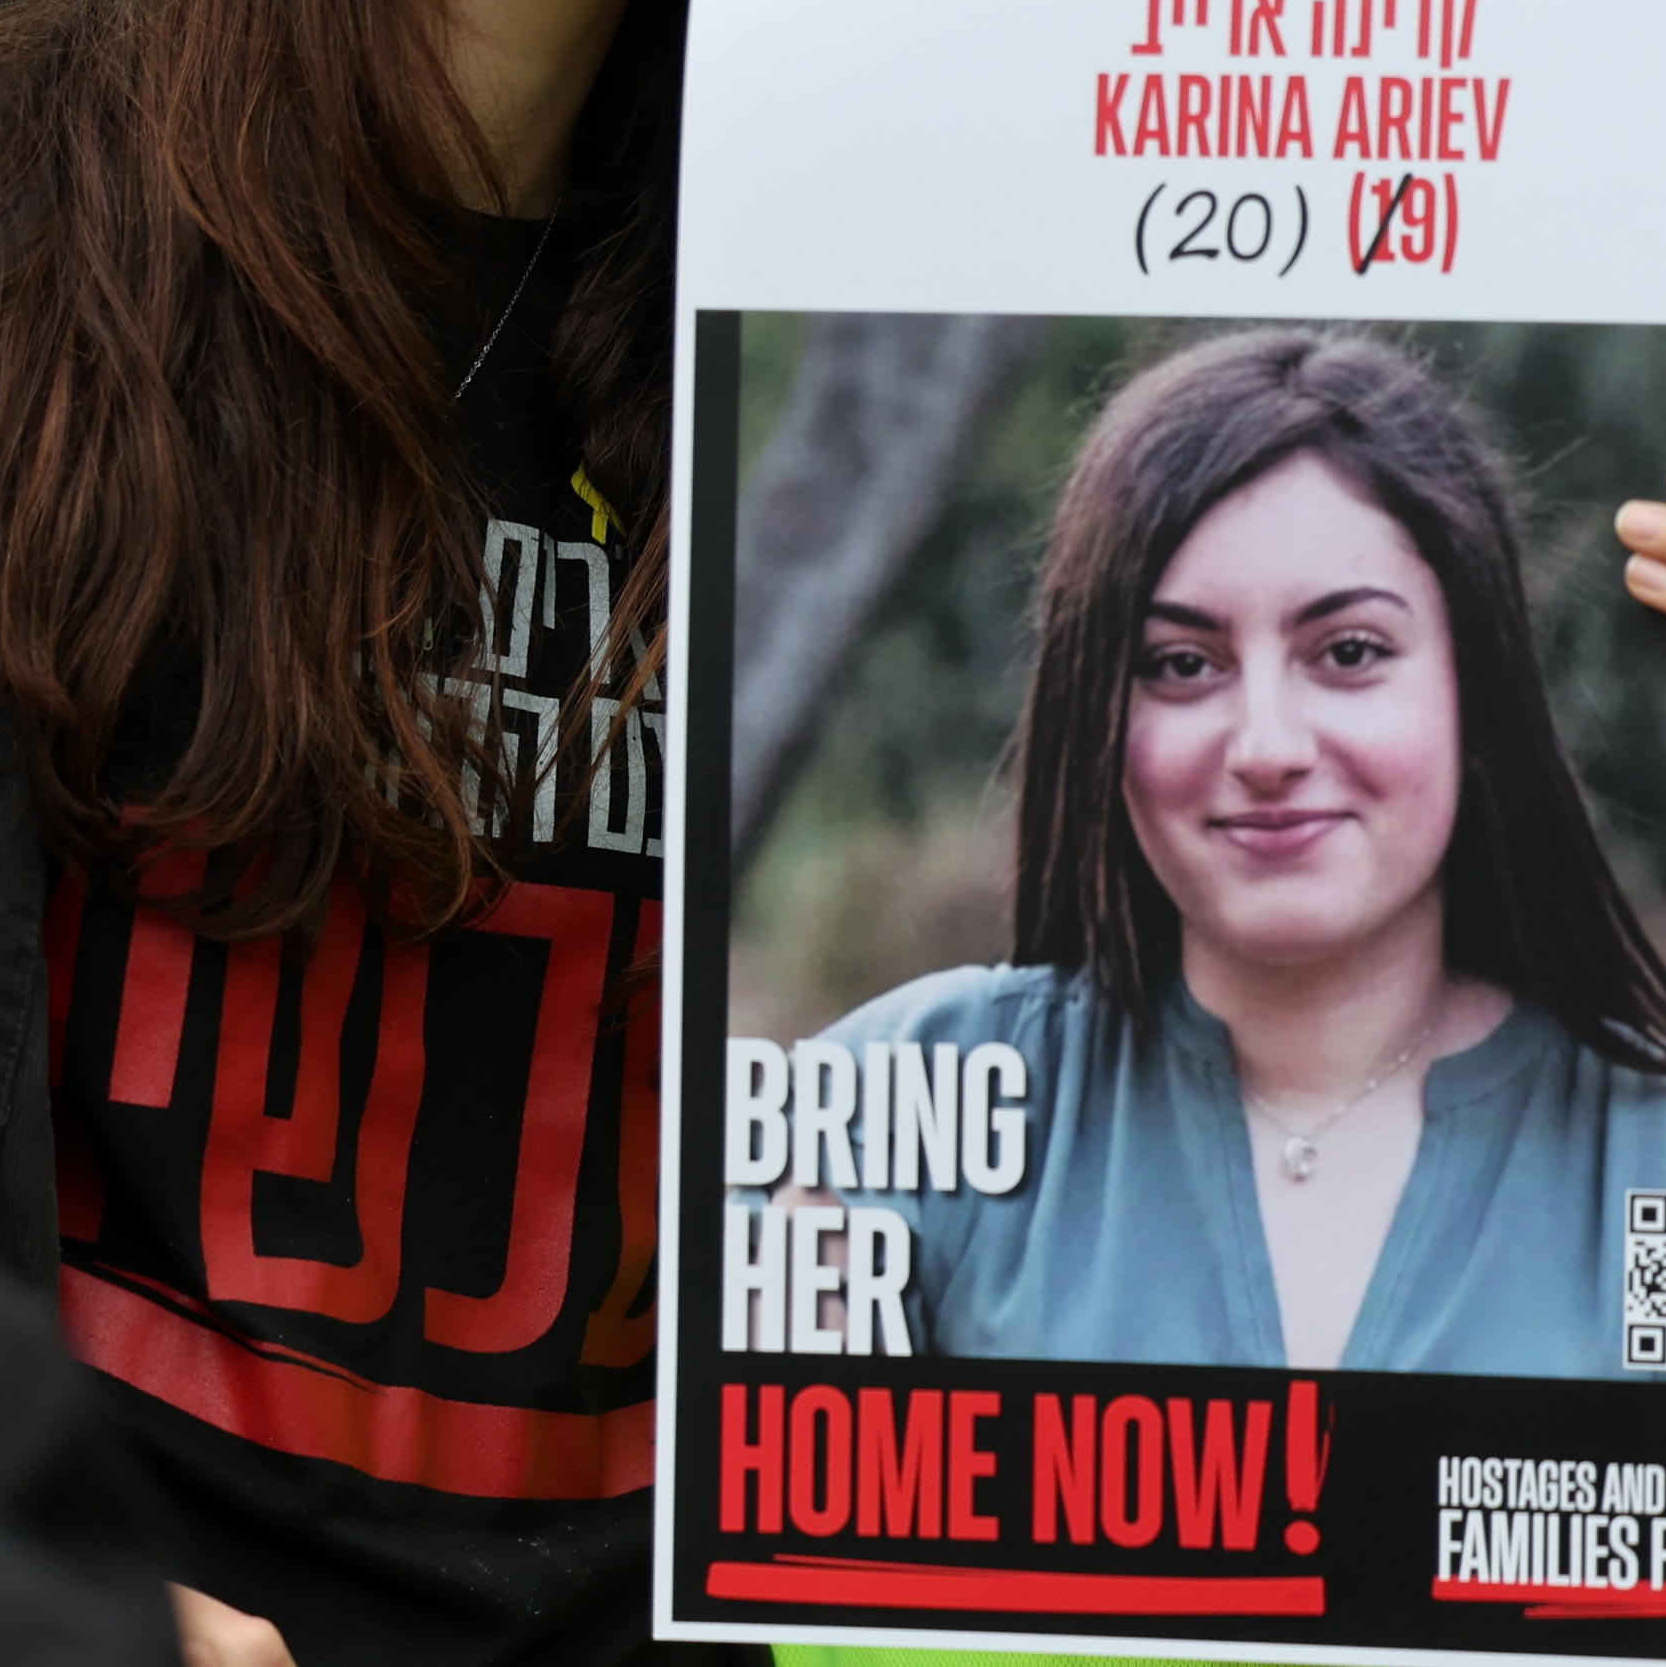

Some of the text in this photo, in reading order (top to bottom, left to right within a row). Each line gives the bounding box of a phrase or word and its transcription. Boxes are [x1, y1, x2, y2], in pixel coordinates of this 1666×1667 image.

[1094, 73, 1511, 161] KARINA ARIEV
[1135, 183, 1309, 277] (20)
[1347, 172, 1459, 275] (19)
[724, 1037, 1027, 1194] BRING
[721, 1203, 913, 1357] HER
[719, 1379, 1332, 1556] HOME NOW!
[1438, 1456, 1597, 1513] HOSTAGES
[1601, 1462, 1666, 1516] AND
[1438, 1508, 1640, 1591] FAMILIES
